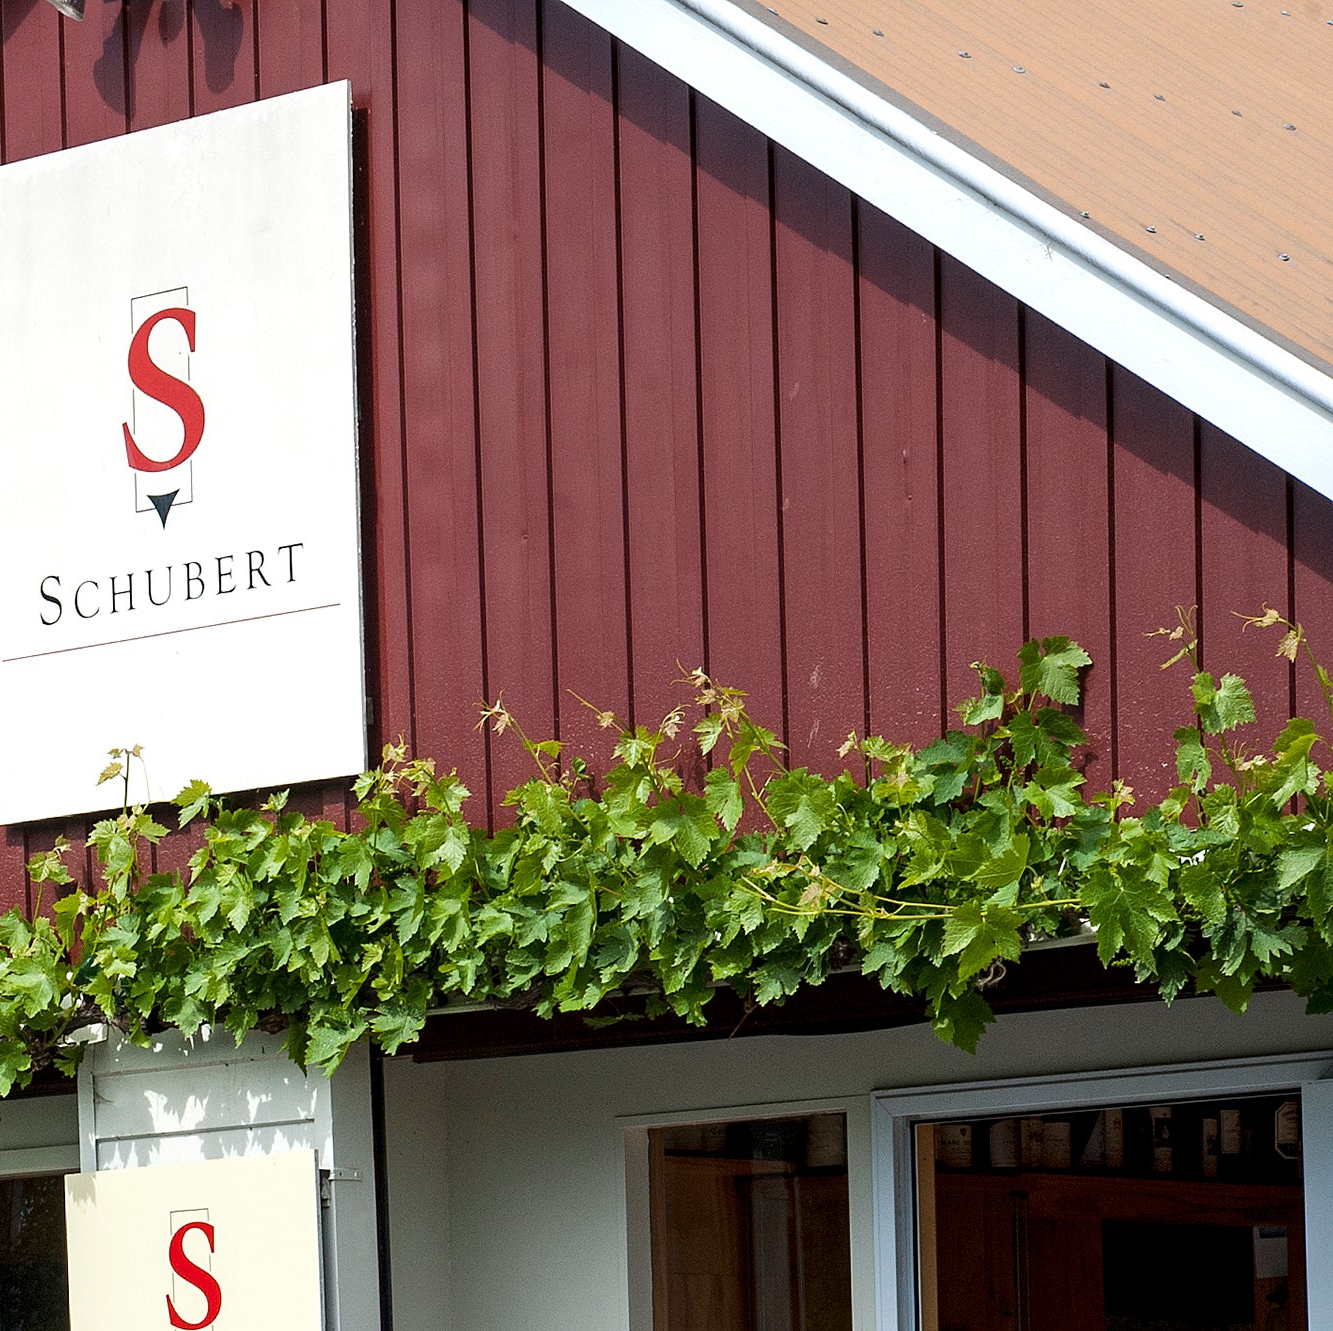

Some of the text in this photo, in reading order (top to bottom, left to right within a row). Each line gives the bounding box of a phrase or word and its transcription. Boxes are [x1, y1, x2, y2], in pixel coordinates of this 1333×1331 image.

[122, 307, 206, 472] S
[39, 542, 305, 627] SCHUBERT
[165, 1221, 222, 1331] S
